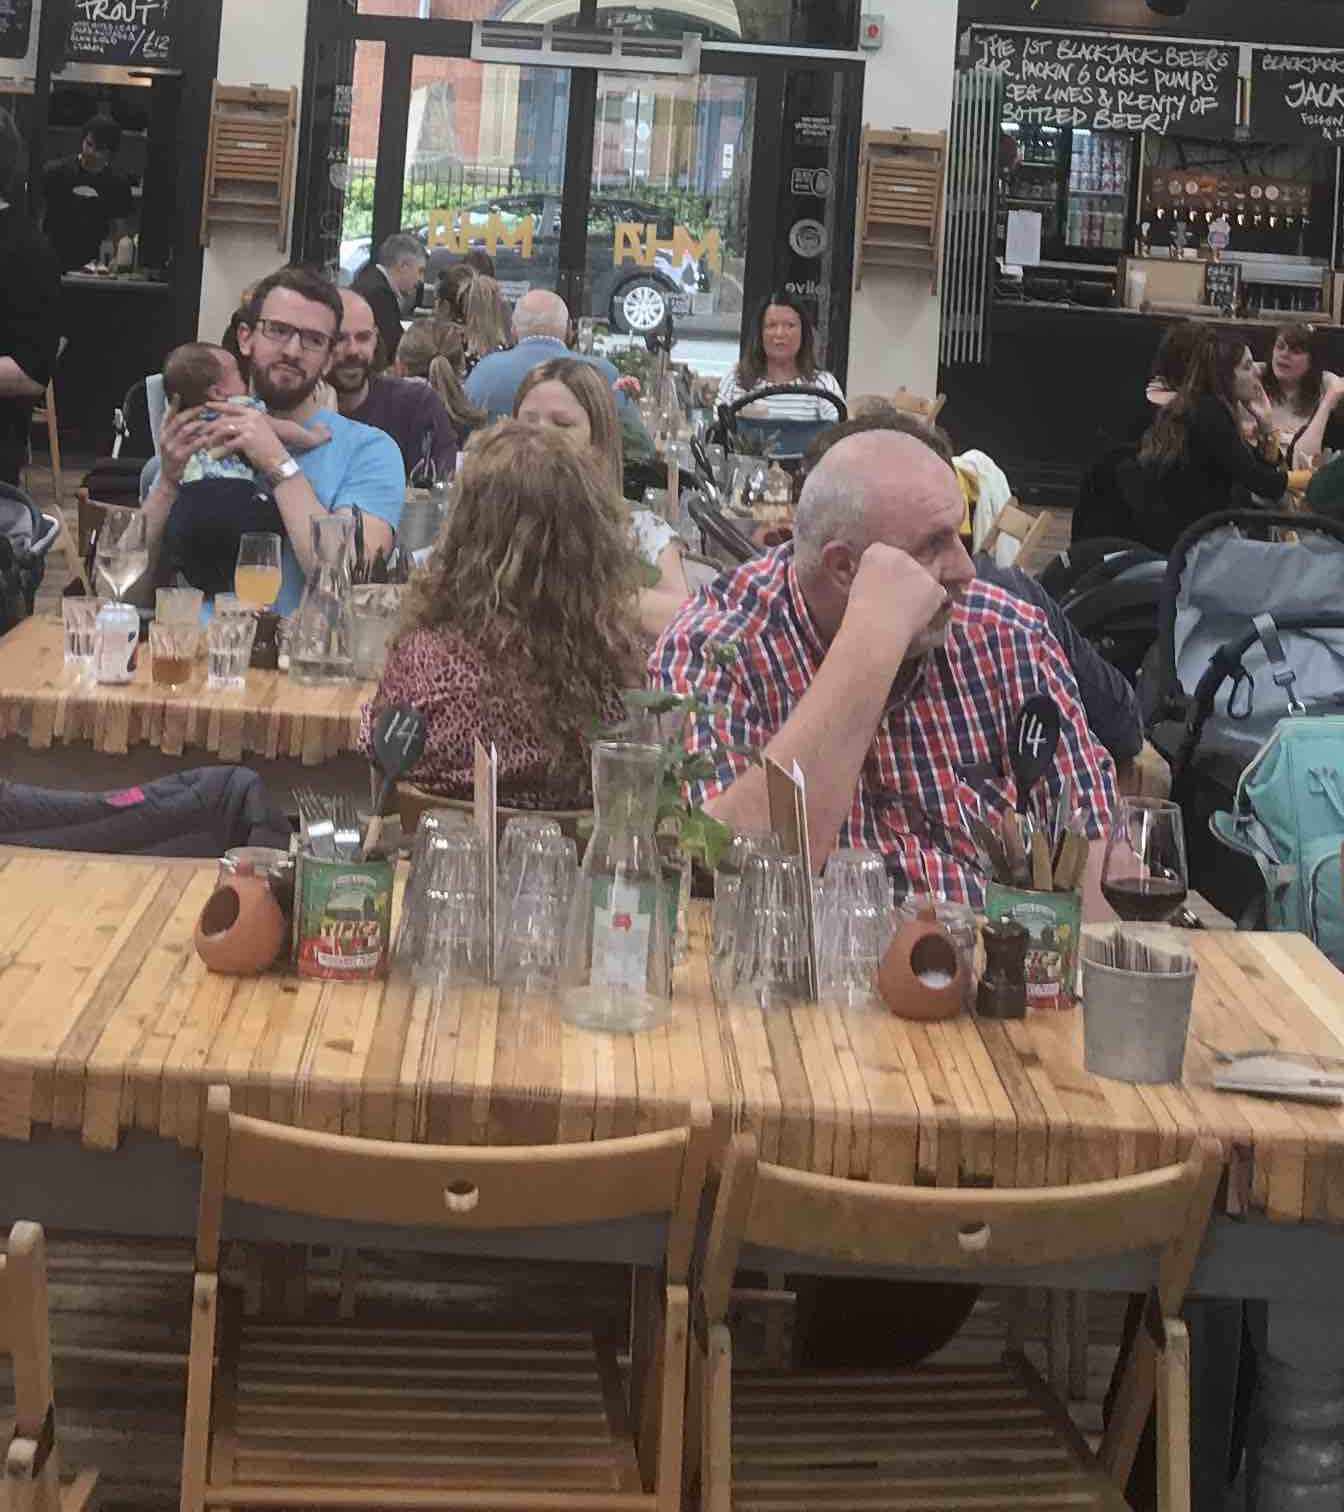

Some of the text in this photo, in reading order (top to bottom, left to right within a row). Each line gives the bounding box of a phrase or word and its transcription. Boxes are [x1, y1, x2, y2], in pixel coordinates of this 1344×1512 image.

[1057, 42, 1163, 65] BLACKJACK
[1165, 46, 1230, 72] BEERS
[1096, 68, 1150, 86] CASK
[1045, 86, 1093, 105] LINES
[1118, 90, 1186, 120] PLENTY
[1190, 96, 1219, 115] OF
[384, 710, 419, 755] 14
[1019, 712, 1046, 759] 14
